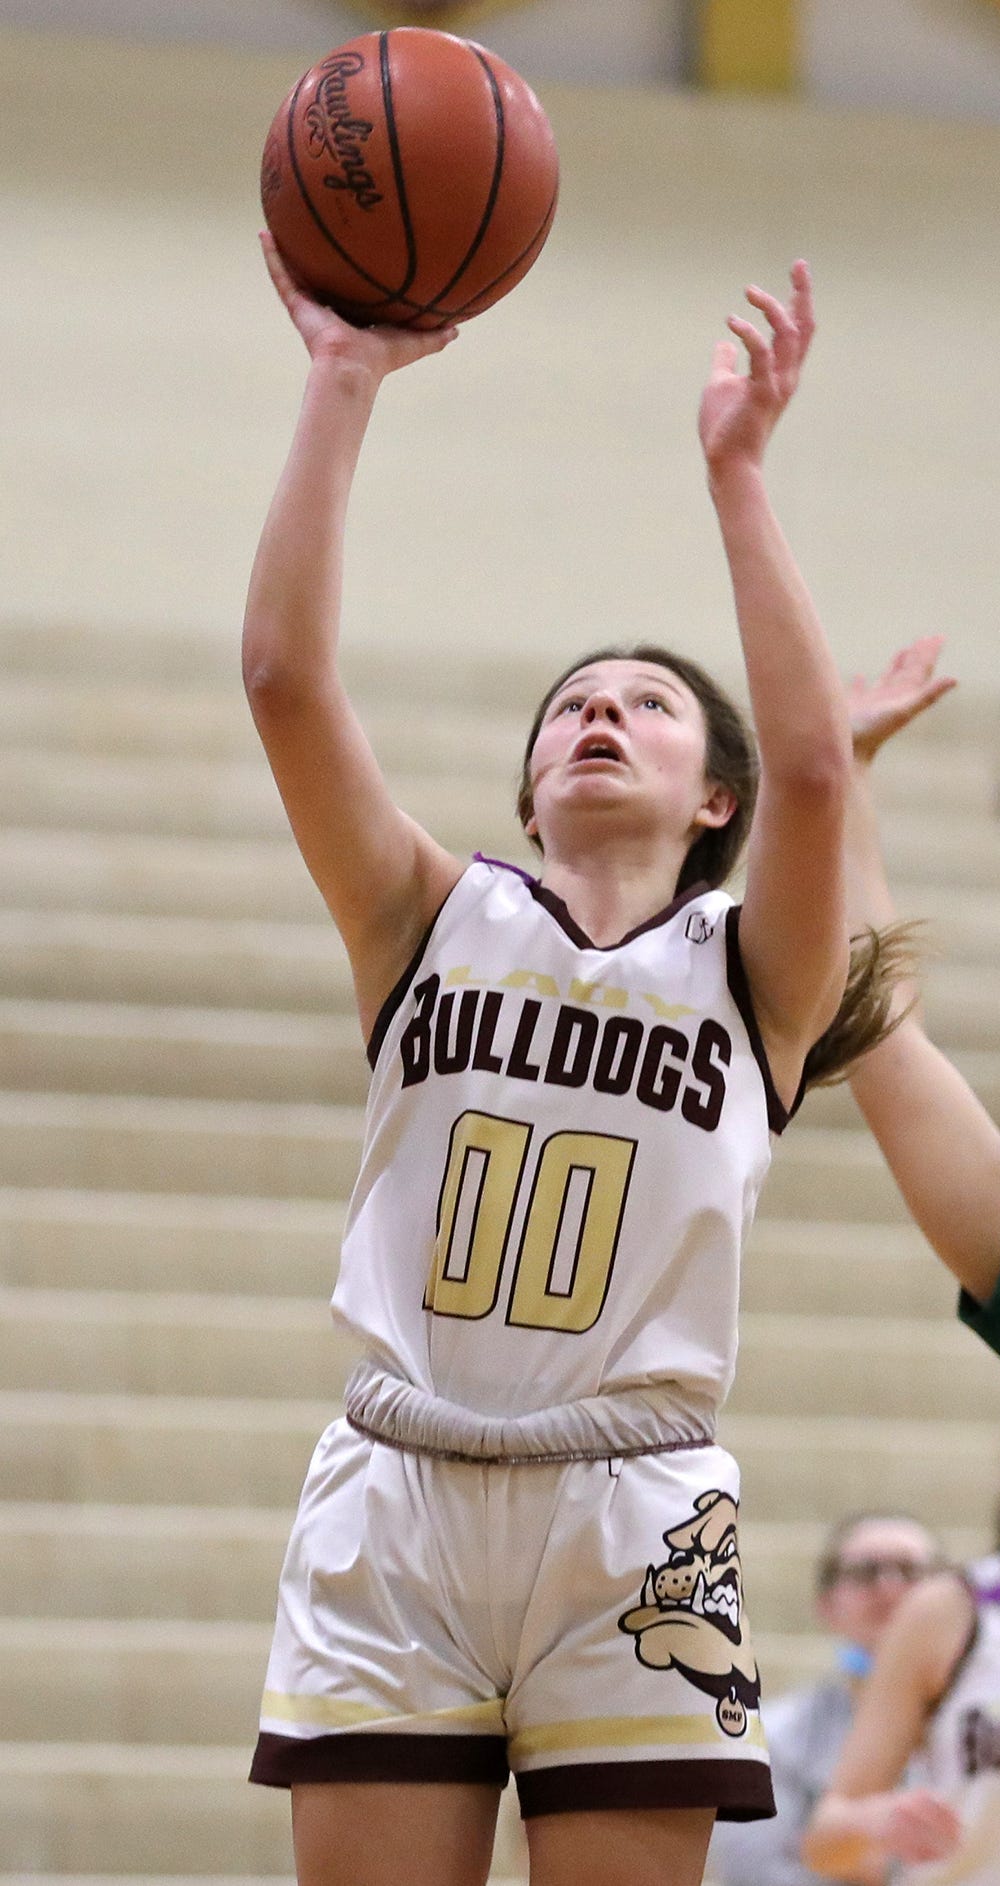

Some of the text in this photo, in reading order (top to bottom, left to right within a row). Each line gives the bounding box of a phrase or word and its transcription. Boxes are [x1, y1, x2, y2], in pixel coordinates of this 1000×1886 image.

[316, 52, 383, 211] Rawlings
[401, 973, 731, 1132] BULLDOGS
[422, 1109, 638, 1334] 00
